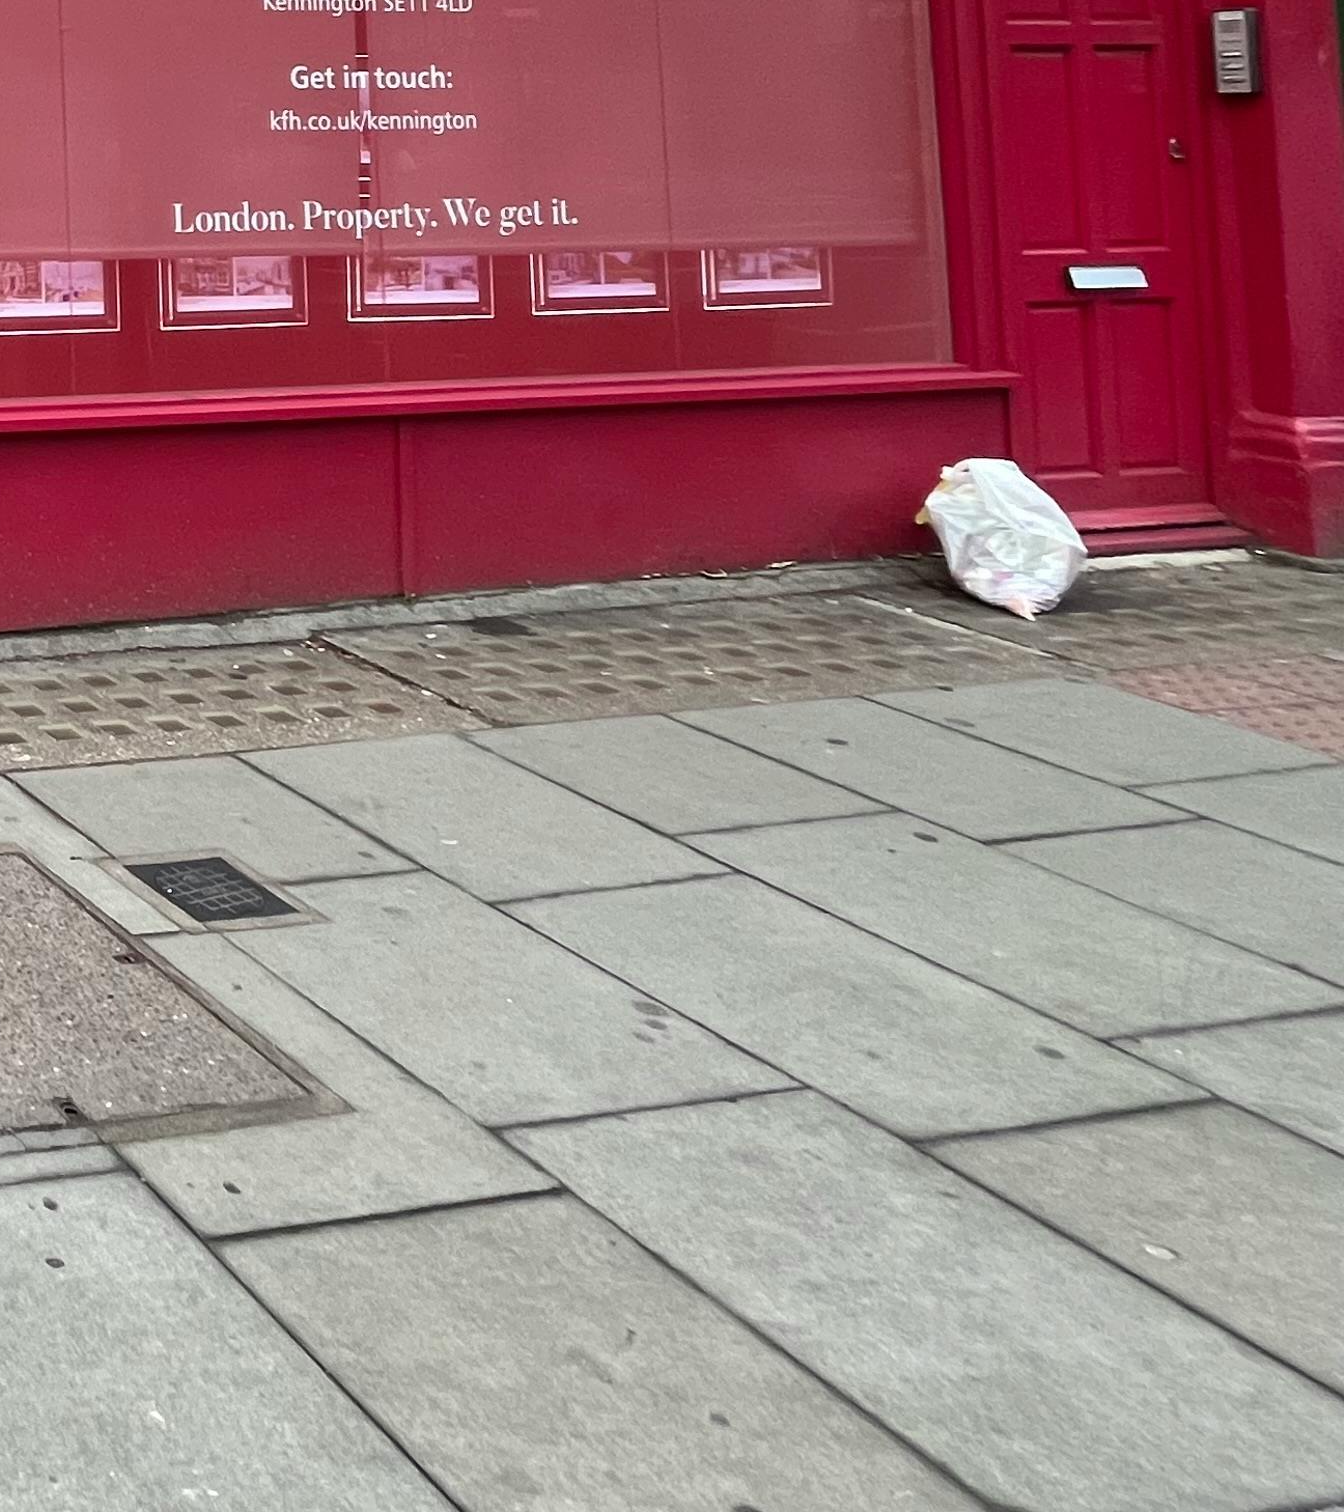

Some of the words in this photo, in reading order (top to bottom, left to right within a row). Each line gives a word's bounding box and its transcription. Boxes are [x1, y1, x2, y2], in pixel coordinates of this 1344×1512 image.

[290, 65, 336, 89] Get
[342, 64, 370, 89] in
[373, 64, 454, 89] touch:
[270, 109, 477, 135] kfh.co.uk/kennington
[173, 200, 295, 233] London.
[302, 200, 438, 239] Property.
[442, 198, 491, 227] We
[499, 200, 544, 236] get
[551, 198, 579, 225] it.
